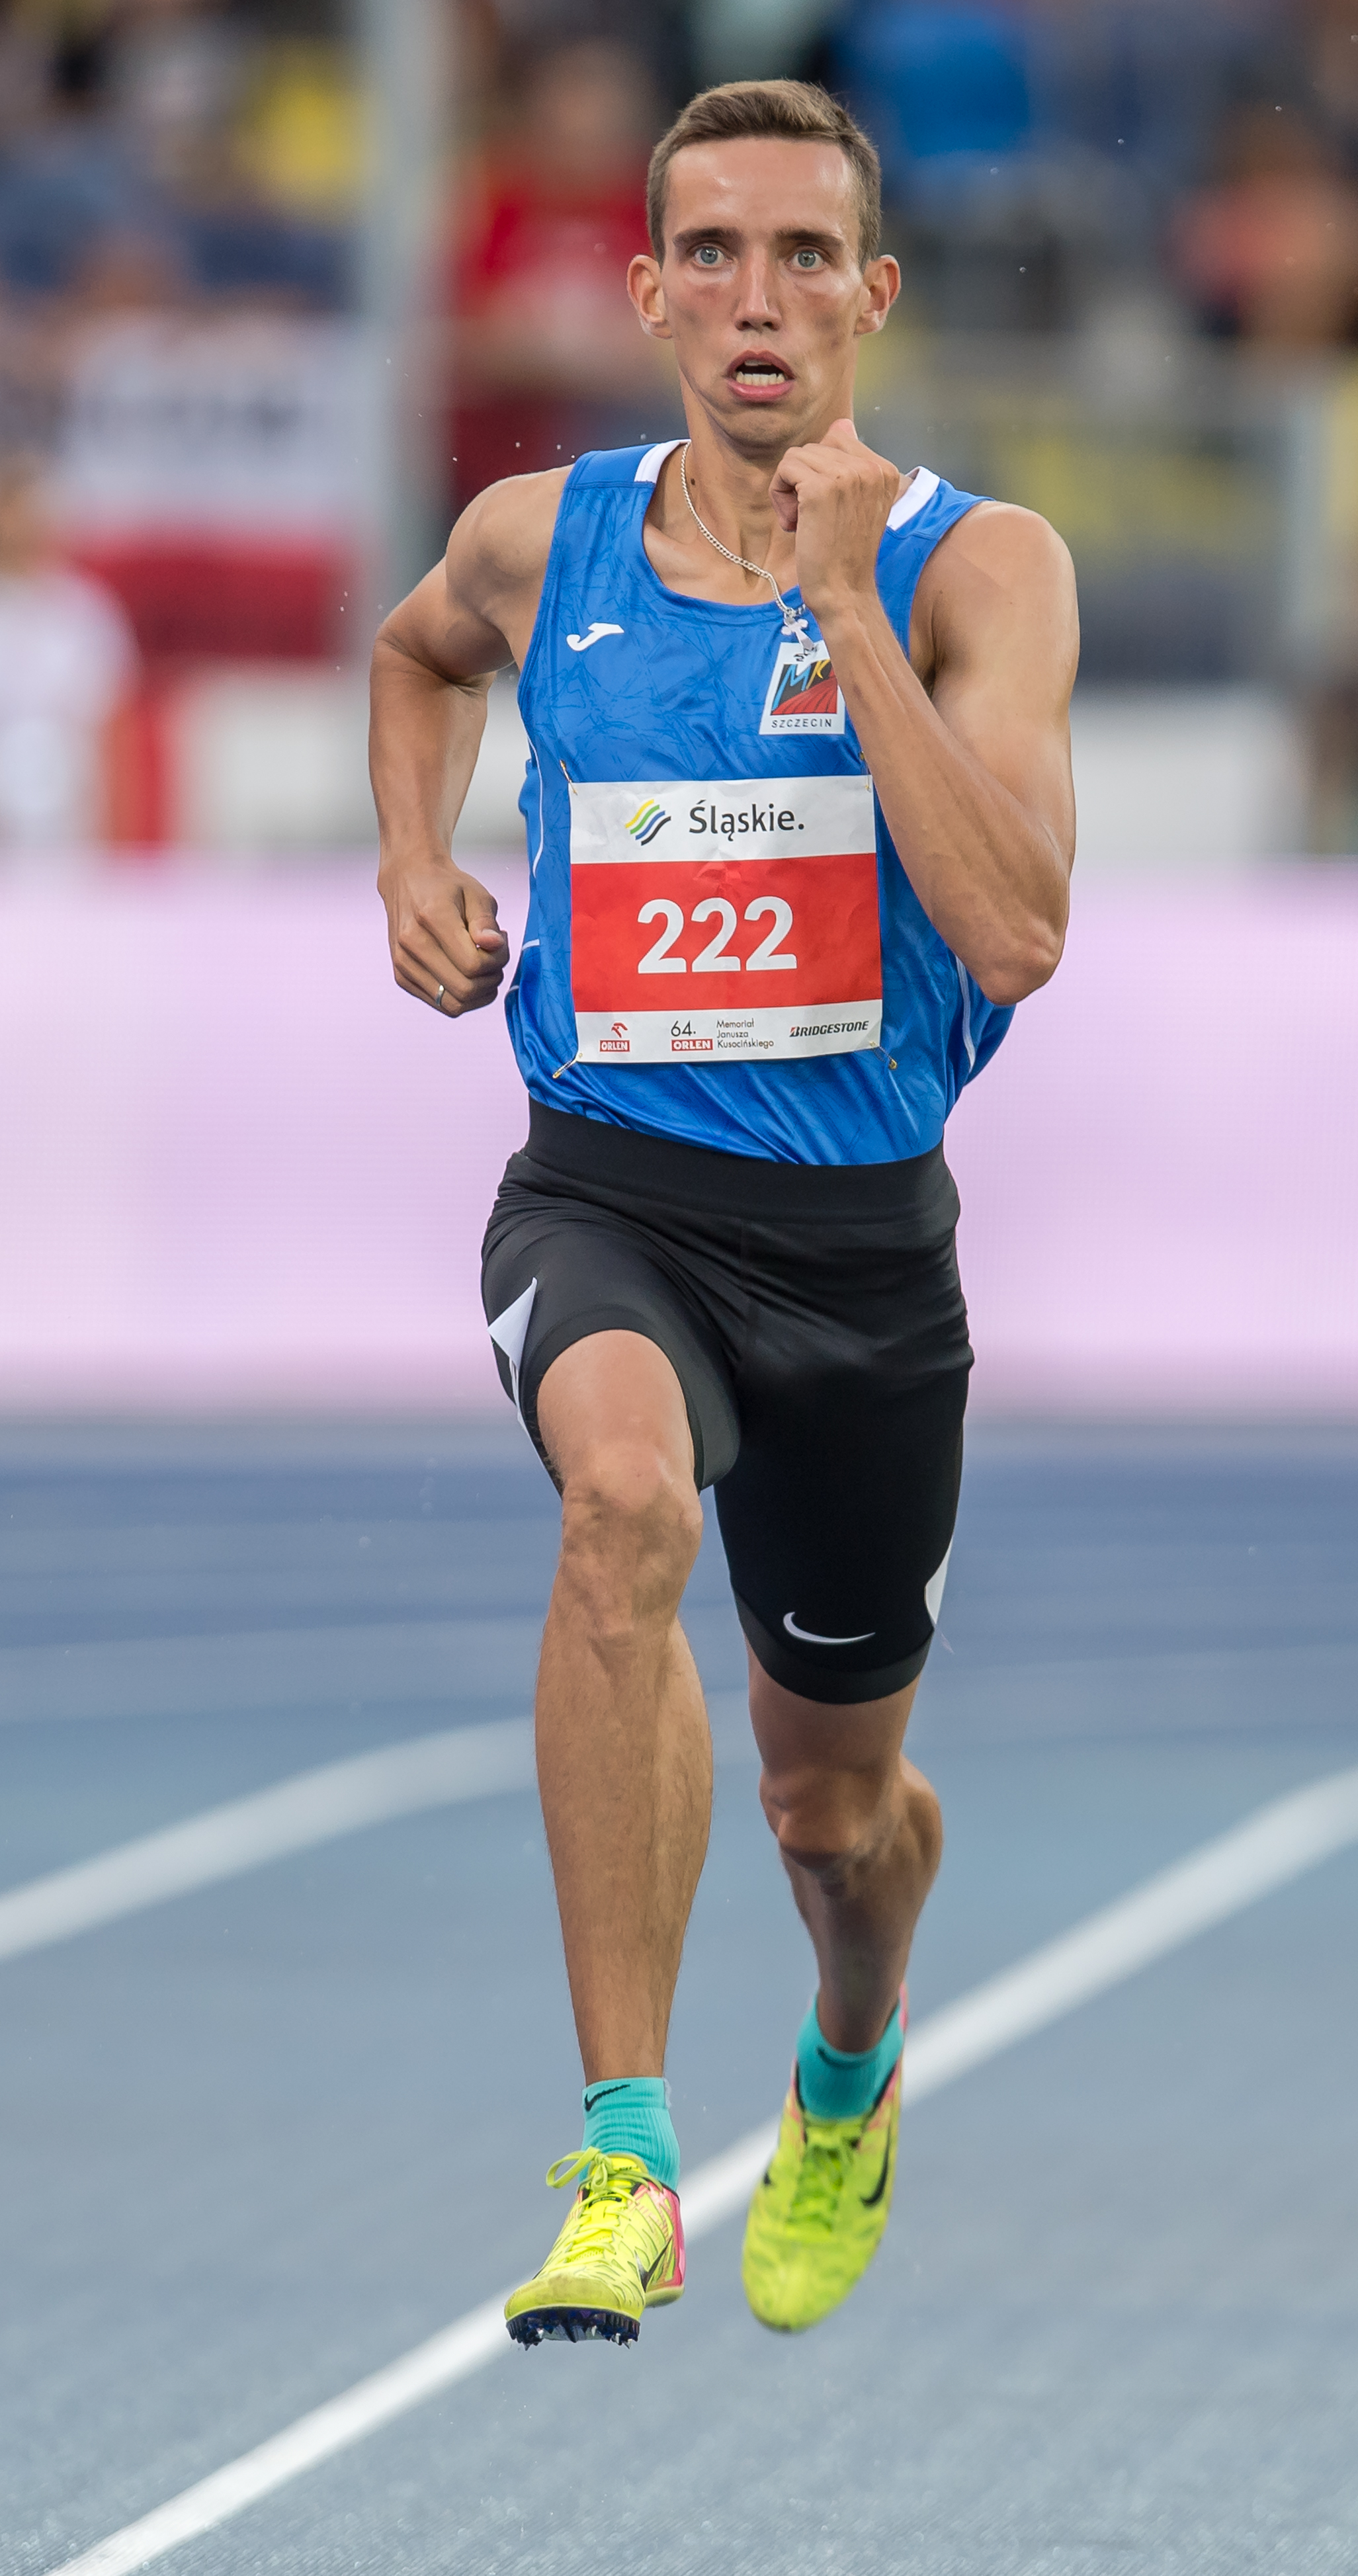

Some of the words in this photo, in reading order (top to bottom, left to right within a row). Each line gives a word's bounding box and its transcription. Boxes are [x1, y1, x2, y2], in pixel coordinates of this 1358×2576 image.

[771, 718, 832, 728] SZCZECIN
[689, 799, 805, 842] Śląskie.
[637, 895, 797, 975] 222
[671, 1020, 697, 1037] 64.
[789, 1020, 869, 1037] BRIDGESTONE
[601, 1041, 628, 1051] ORLEN
[673, 1040, 711, 1050] ORLEN
[717, 1039, 775, 1050] Kusocińskiego
